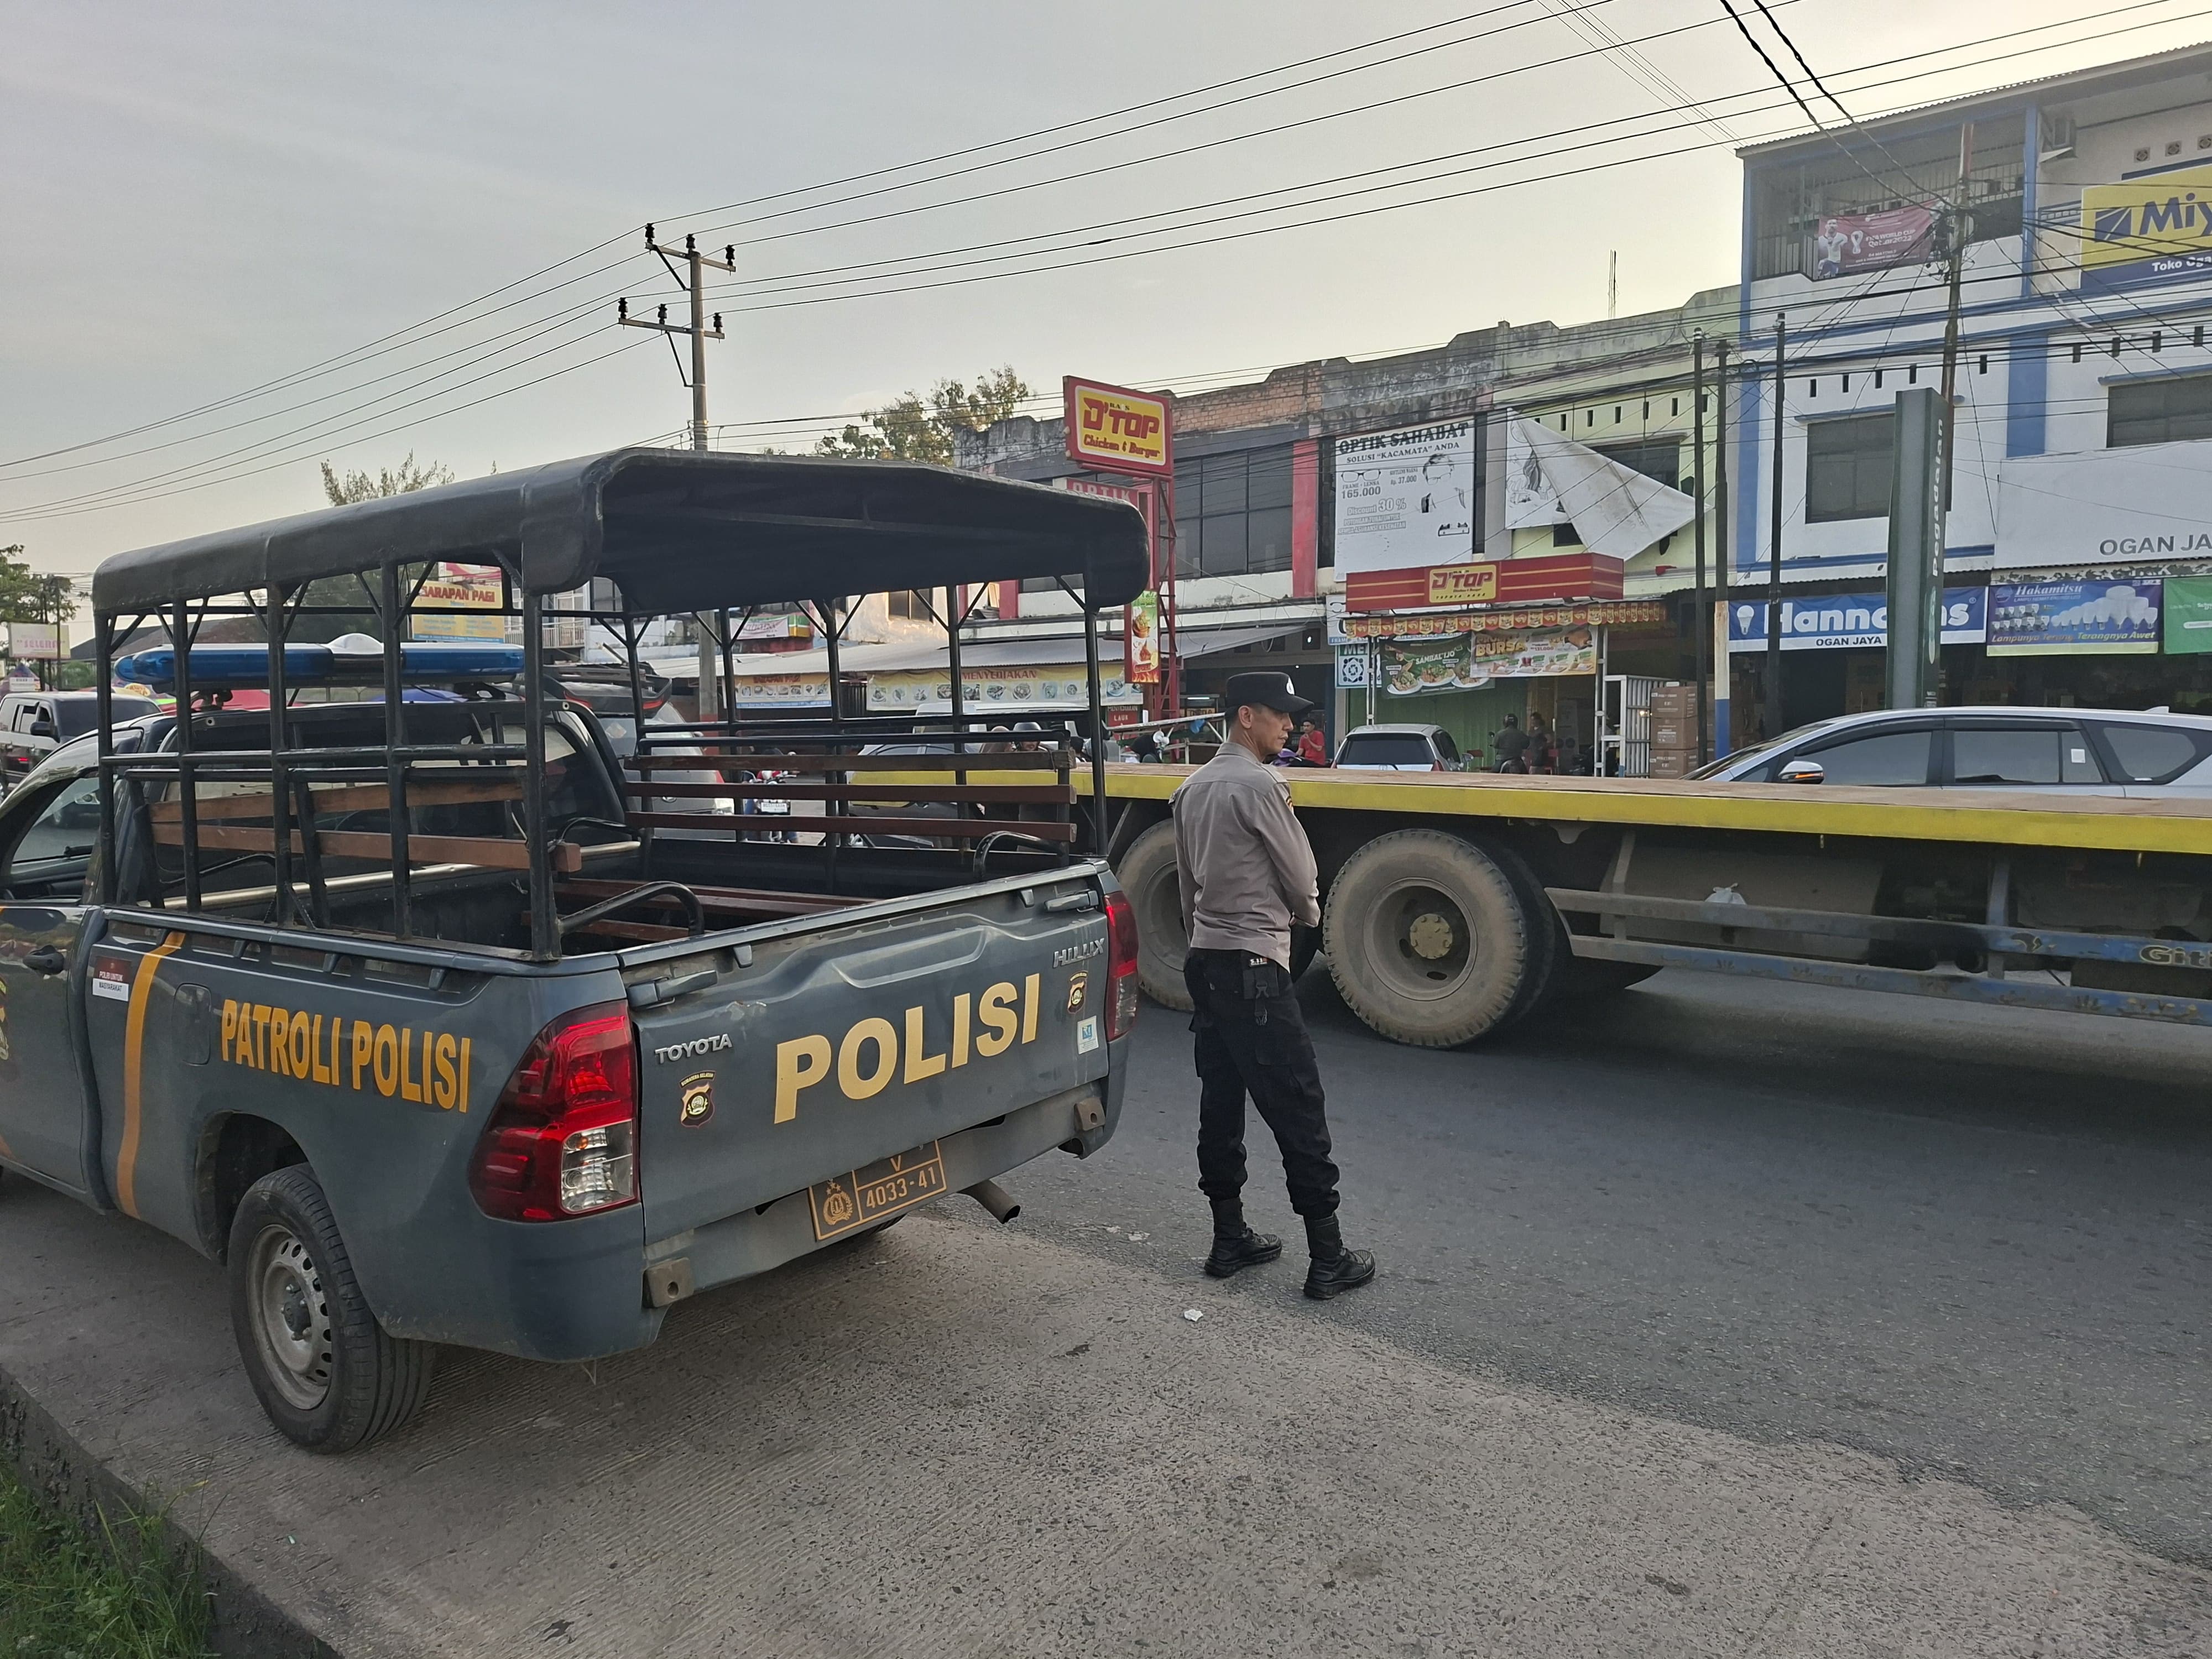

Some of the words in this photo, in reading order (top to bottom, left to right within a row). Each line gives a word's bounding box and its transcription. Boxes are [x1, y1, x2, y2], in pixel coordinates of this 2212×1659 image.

[2152, 260, 2182, 272] Toko
[1084, 434, 1119, 451] Chicken
[1129, 442, 1160, 458] Burger
[1339, 434, 1386, 455] OPTIK
[1389, 422, 1469, 447] SAHABAT
[1347, 454, 1375, 463] SOLUSI
[1434, 442, 1459, 451] ANDA
[1398, 475, 1417, 484] 37.000
[1341, 486, 1381, 499] 165.000
[1932, 419, 1943, 576] Pegadaian
[1348, 505, 1377, 515] Discount
[1378, 498, 1395, 512] 30
[2100, 536, 2174, 555] OGAN
[421, 586, 469, 601] SARAPAN
[472, 589, 495, 603] PAGI
[2016, 585, 2083, 596] Hakamitsu
[1816, 637, 1849, 646] OGAN
[1853, 636, 1881, 645] JAYA
[1992, 634, 2039, 643] Lampunya
[2078, 632, 2128, 641] Terangnya
[962, 670, 1037, 680] MENYEDIAKAN
[1053, 938, 1104, 968] HILUX
[222, 999, 341, 1086] PATROLI
[352, 1020, 471, 1113] POLISI
[655, 1034, 732, 1064] TOYOTA
[774, 973, 1040, 1124] POLISI
[866, 1166, 936, 1209] 4033-41
